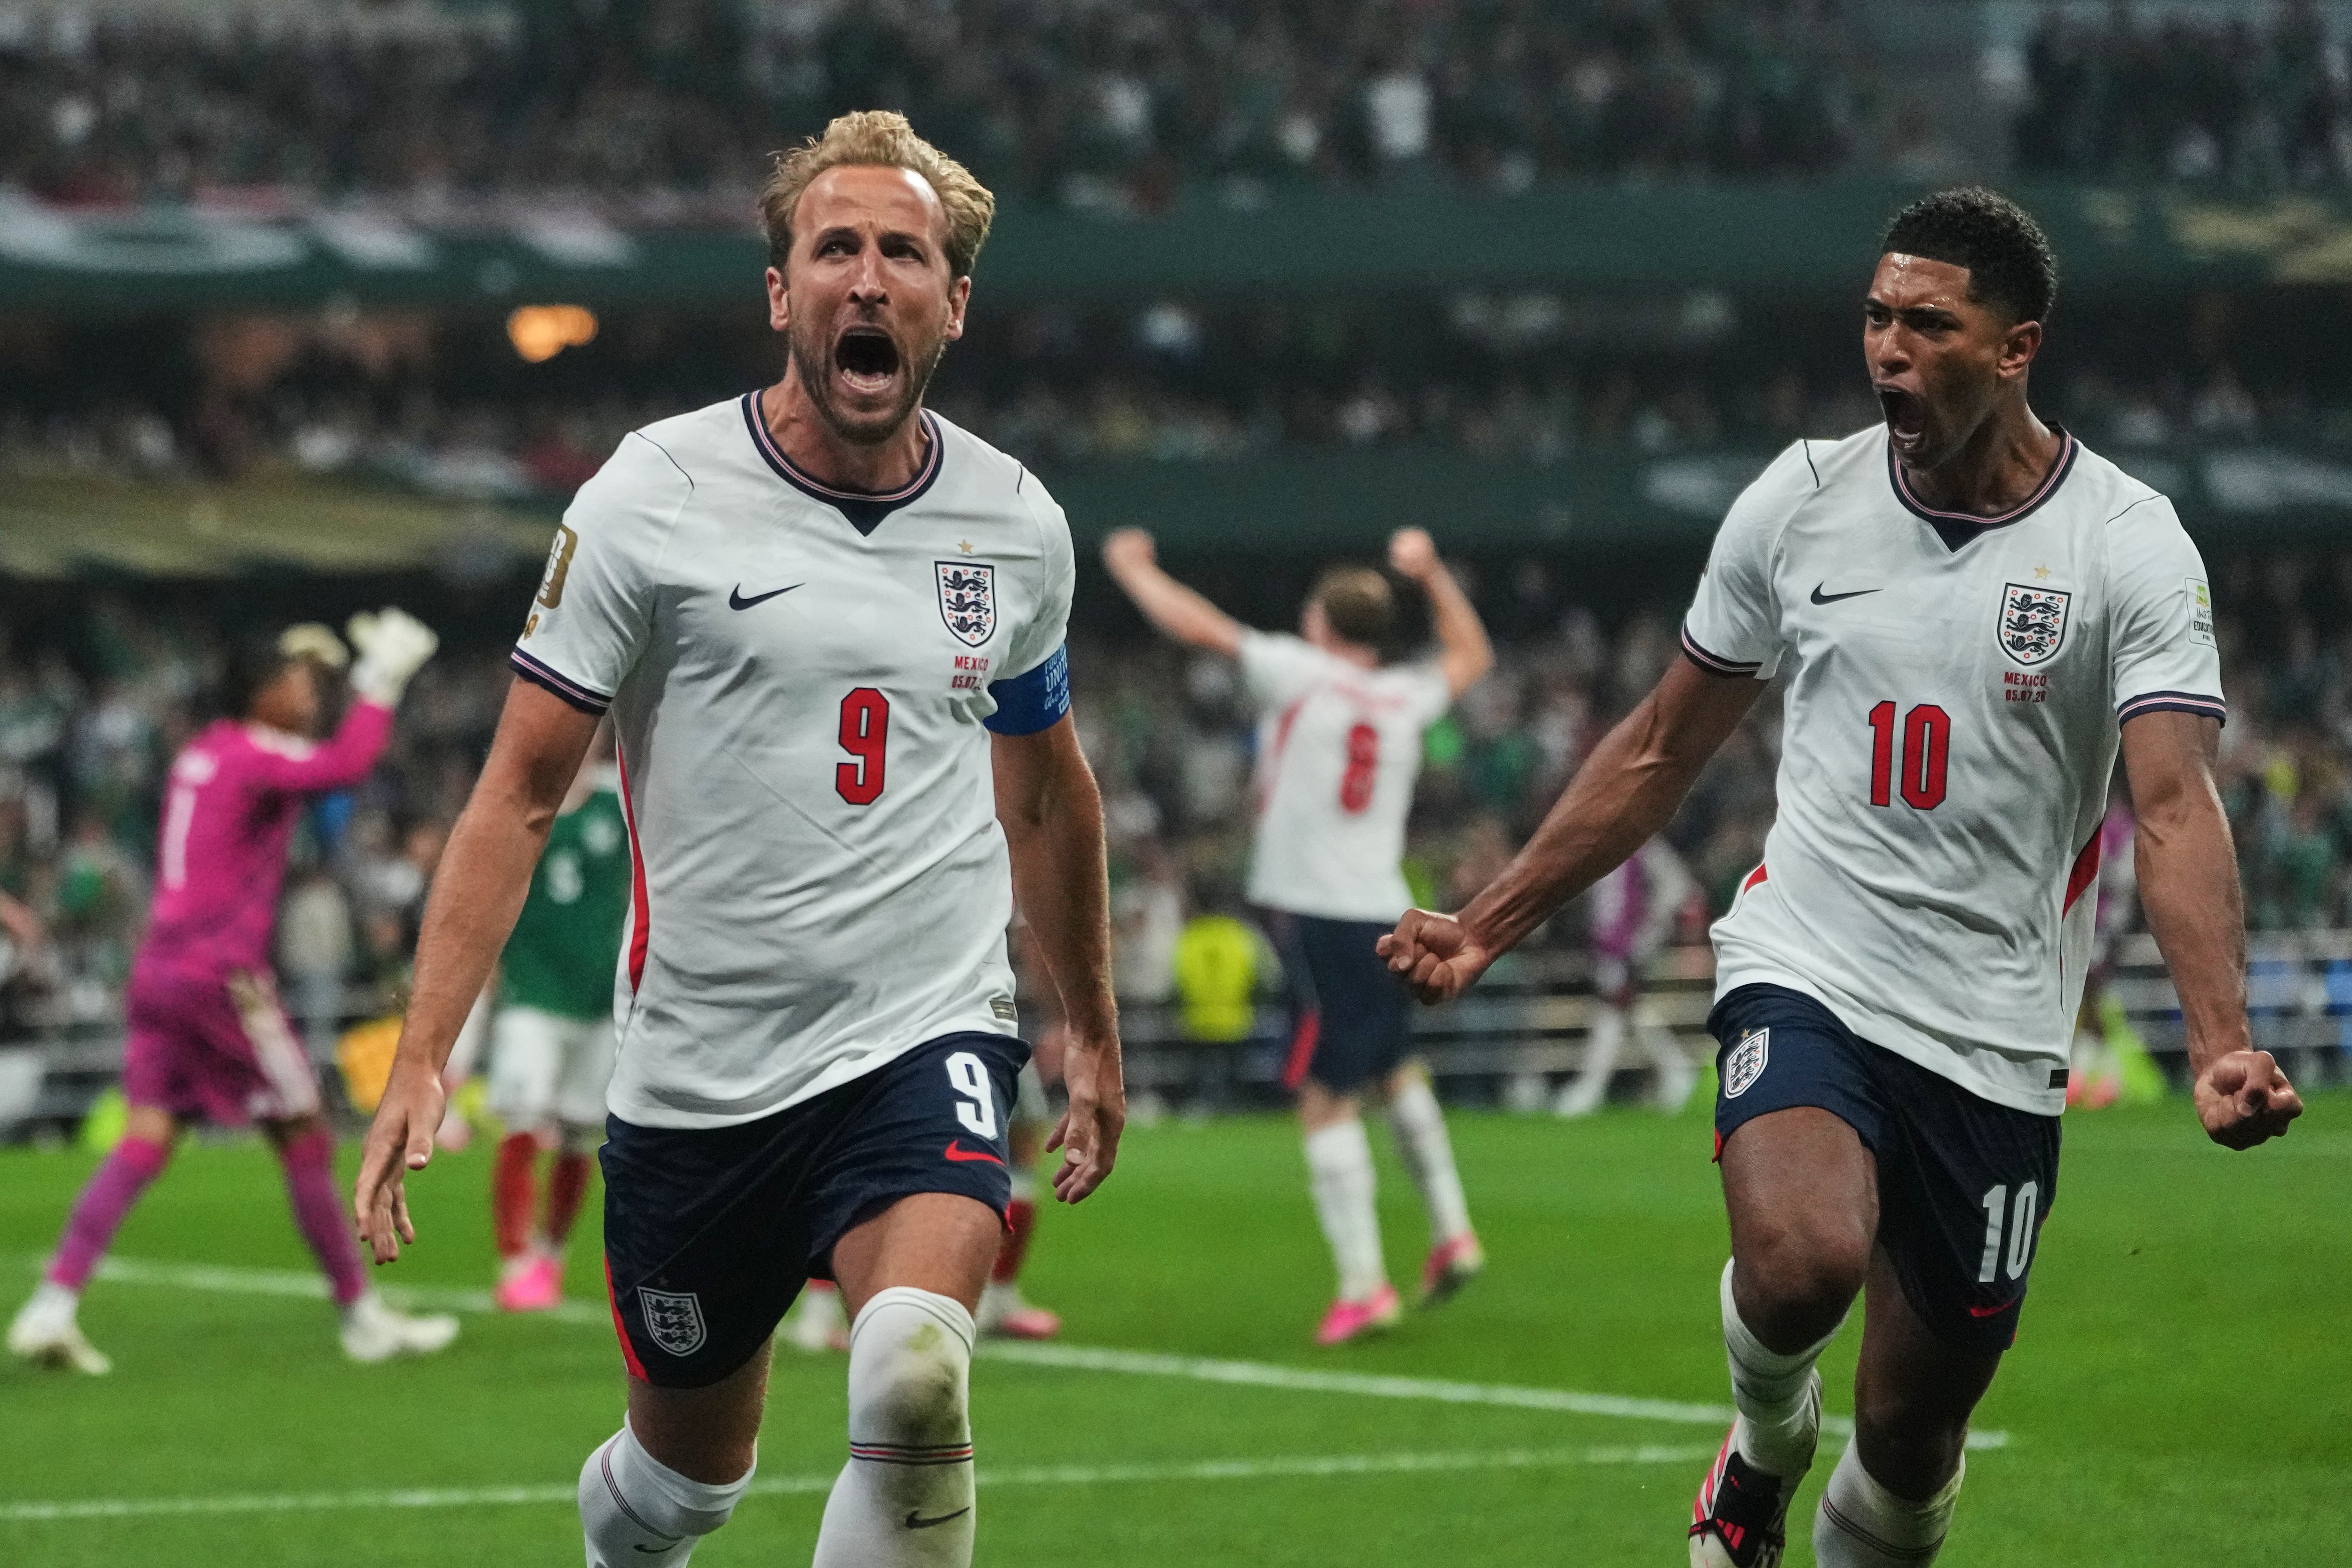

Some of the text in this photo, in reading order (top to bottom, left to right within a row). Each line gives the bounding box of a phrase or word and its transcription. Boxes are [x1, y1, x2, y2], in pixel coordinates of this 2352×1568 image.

[954, 656, 989, 671] MEXICO
[2004, 672, 2047, 687] MEXICO
[835, 687, 890, 805] 9
[1868, 700, 1951, 811] 10
[946, 1052, 999, 1141] 9
[1979, 1180, 2038, 1283] 10
